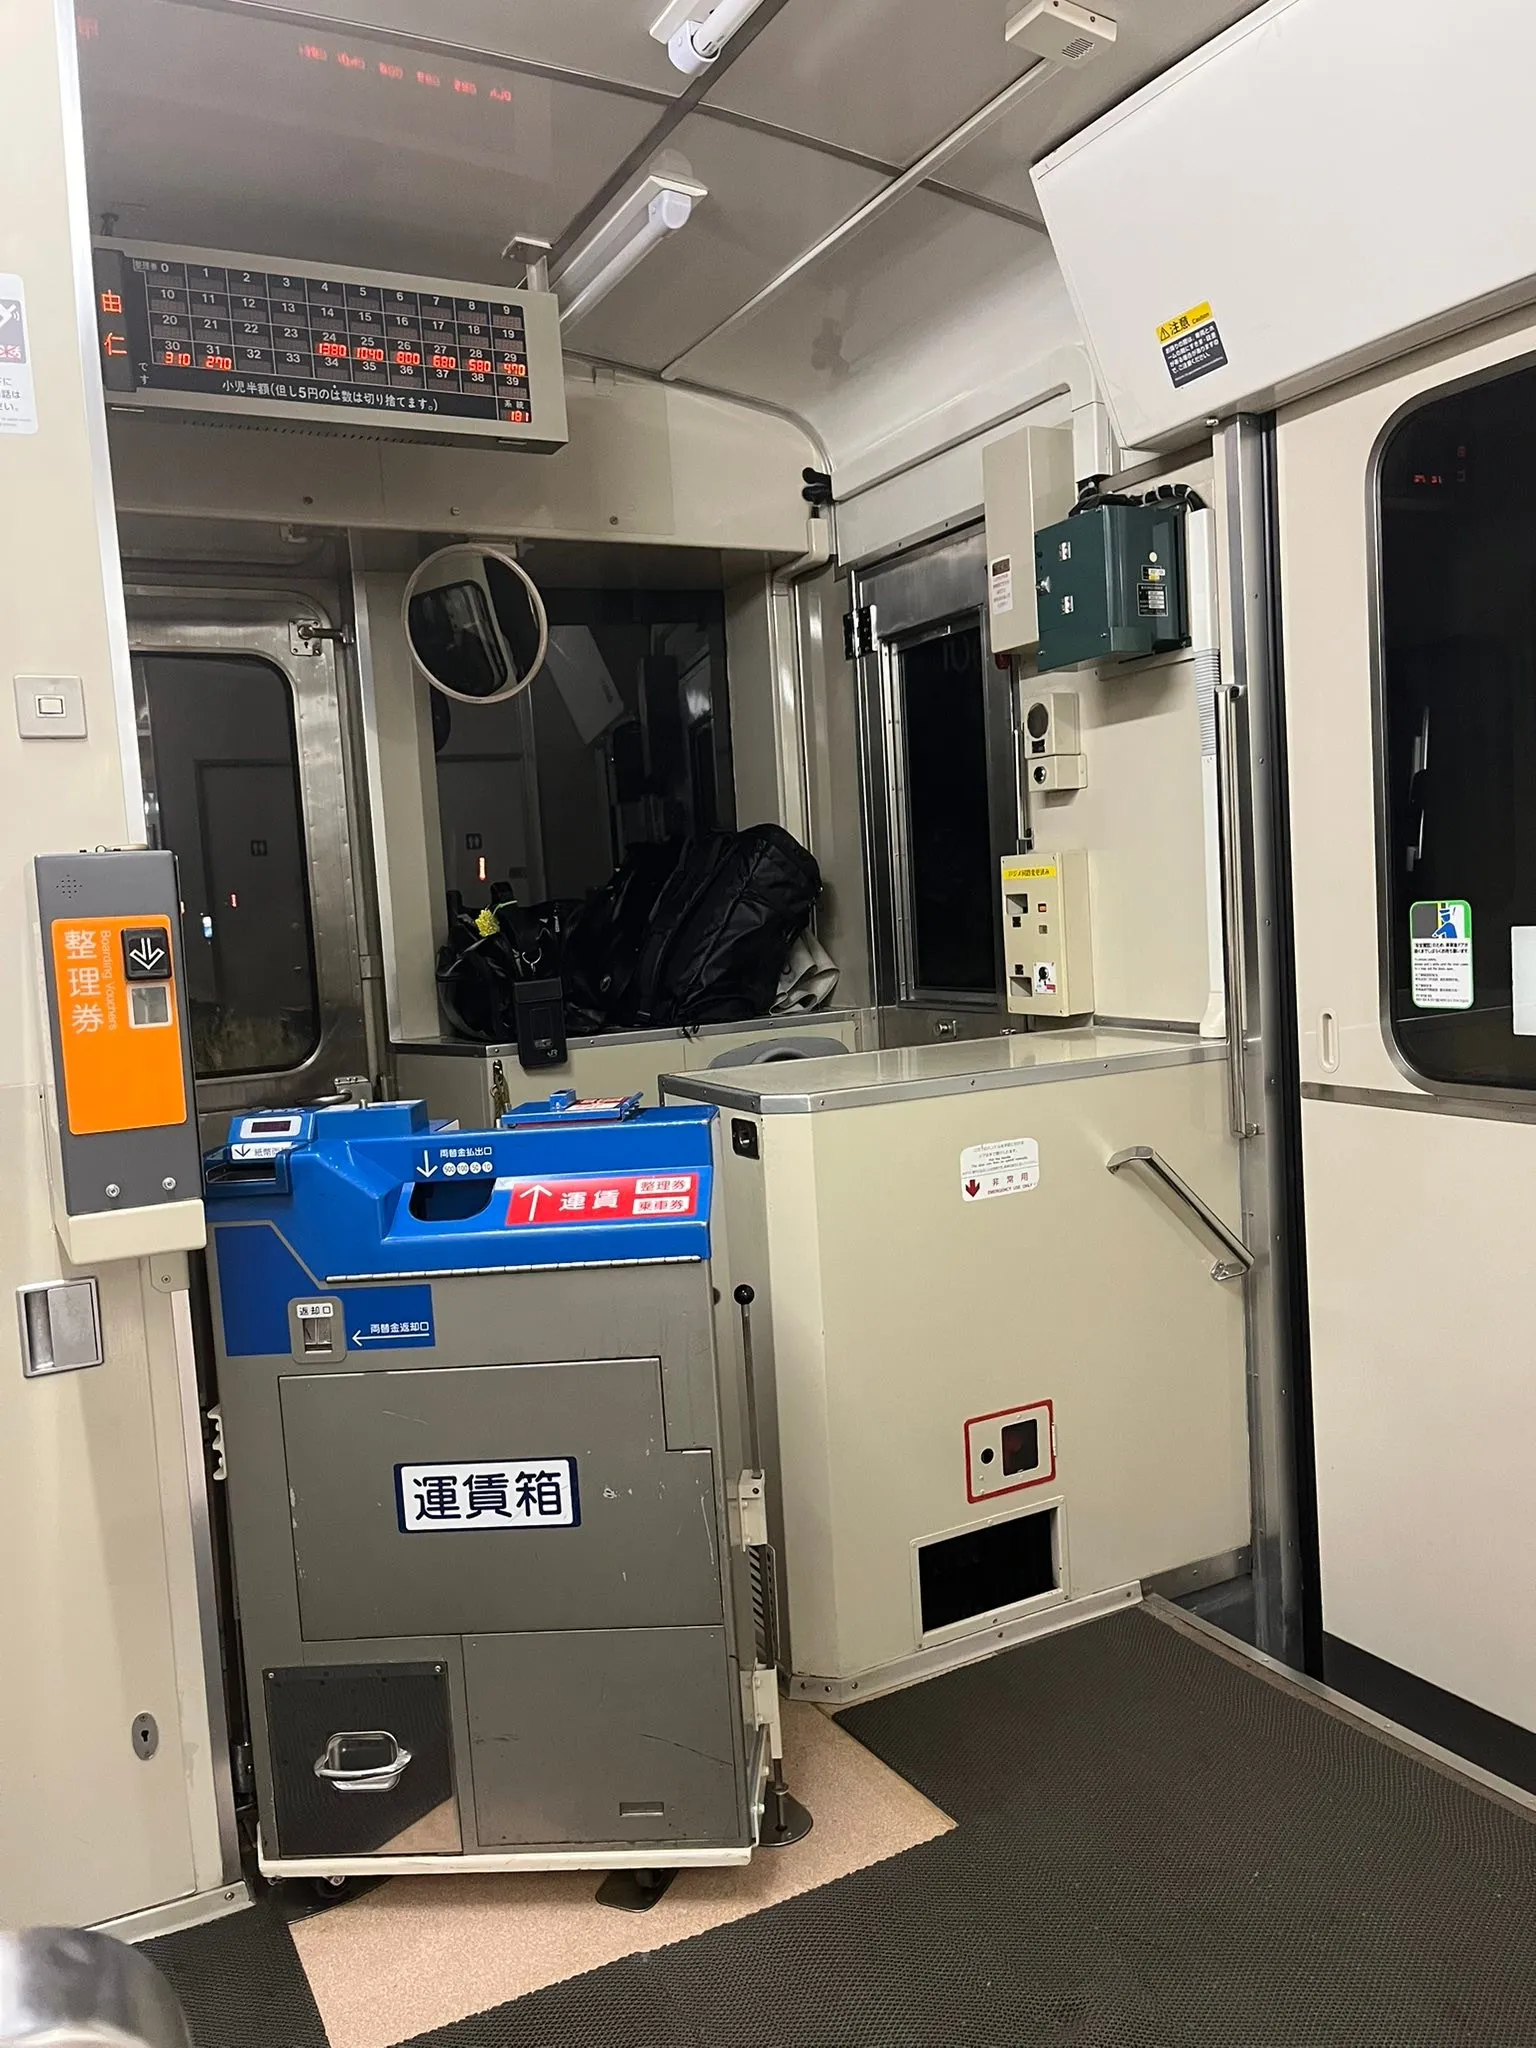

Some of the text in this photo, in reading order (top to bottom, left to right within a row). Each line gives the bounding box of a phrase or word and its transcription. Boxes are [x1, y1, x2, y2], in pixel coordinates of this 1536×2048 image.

[161, 263, 510, 315] 0 1 2 3 4 5 6 7 8 9
[101, 289, 127, 356] 由仁
[160, 289, 515, 339] 10 11 12 13 14 15 16 17 18 19
[1169, 315, 1190, 336] 注意
[162, 315, 517, 363] 20 21 22 23 24 25 26 27 28 29
[165, 351, 232, 370] 310 270
[165, 340, 519, 386] 30 31 32 33 34 35 36 37 38 39
[319, 343, 526, 377] 1380 1040 800 680 580 470
[138, 361, 149, 386] です
[509, 410, 529, 423] 181
[64, 928, 104, 1034] 整理券
[100, 929, 119, 1032] Boarding Vouchers
[440, 1145, 493, 1159] 両替金払出口
[639, 1178, 684, 1192] 整理券
[987, 1186, 1012, 1195] EMERGENCY
[992, 1172, 1028, 1187] 非常用
[558, 1189, 620, 1212] 運賃
[639, 1198, 684, 1212] 乗車券
[299, 1305, 331, 1317] 返却口
[370, 1321, 429, 1335] 両替金返却口
[412, 1469, 562, 1521] 運賃箱
